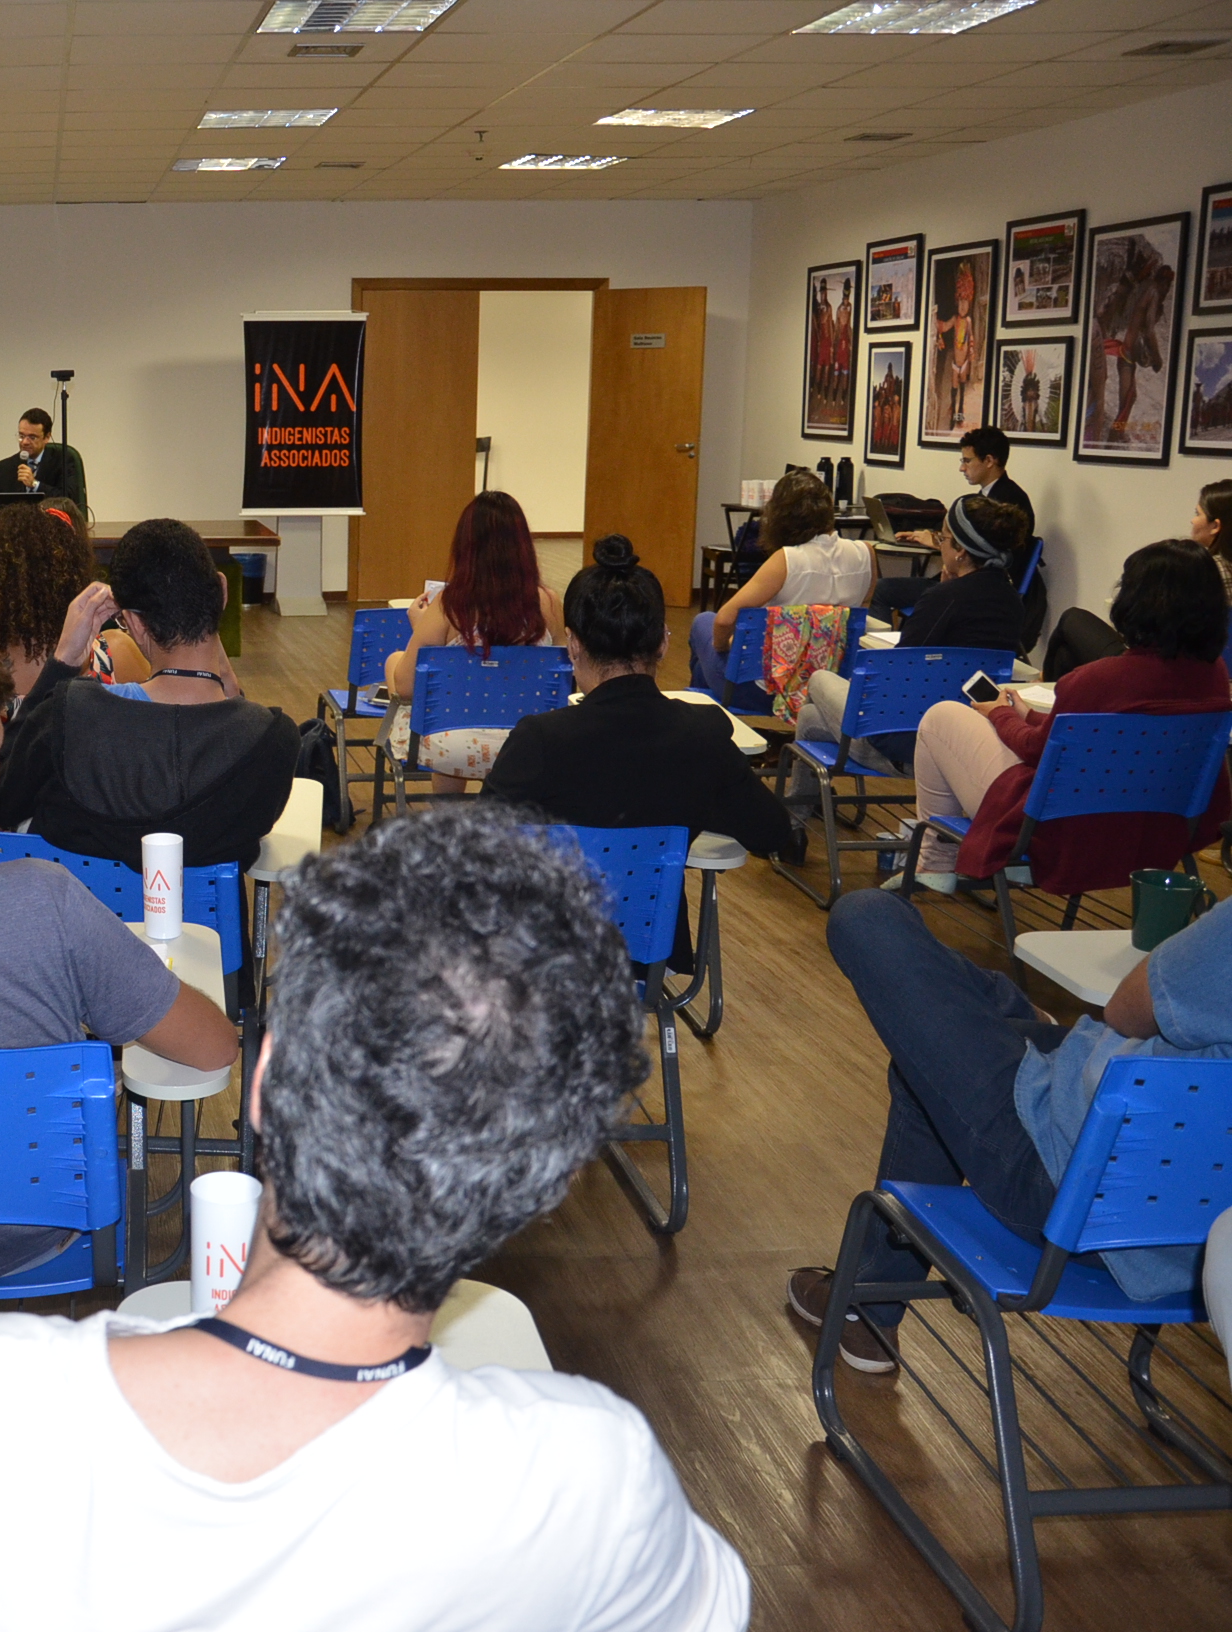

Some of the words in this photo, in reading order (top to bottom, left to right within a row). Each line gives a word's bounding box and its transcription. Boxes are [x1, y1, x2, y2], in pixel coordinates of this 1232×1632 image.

[258, 427, 350, 445] INDIGENISTAS
[260, 449, 350, 467] ASSOCIADOS
[245, 1337, 296, 1370] FUNAI
[356, 1360, 406, 1382] FUNAI
